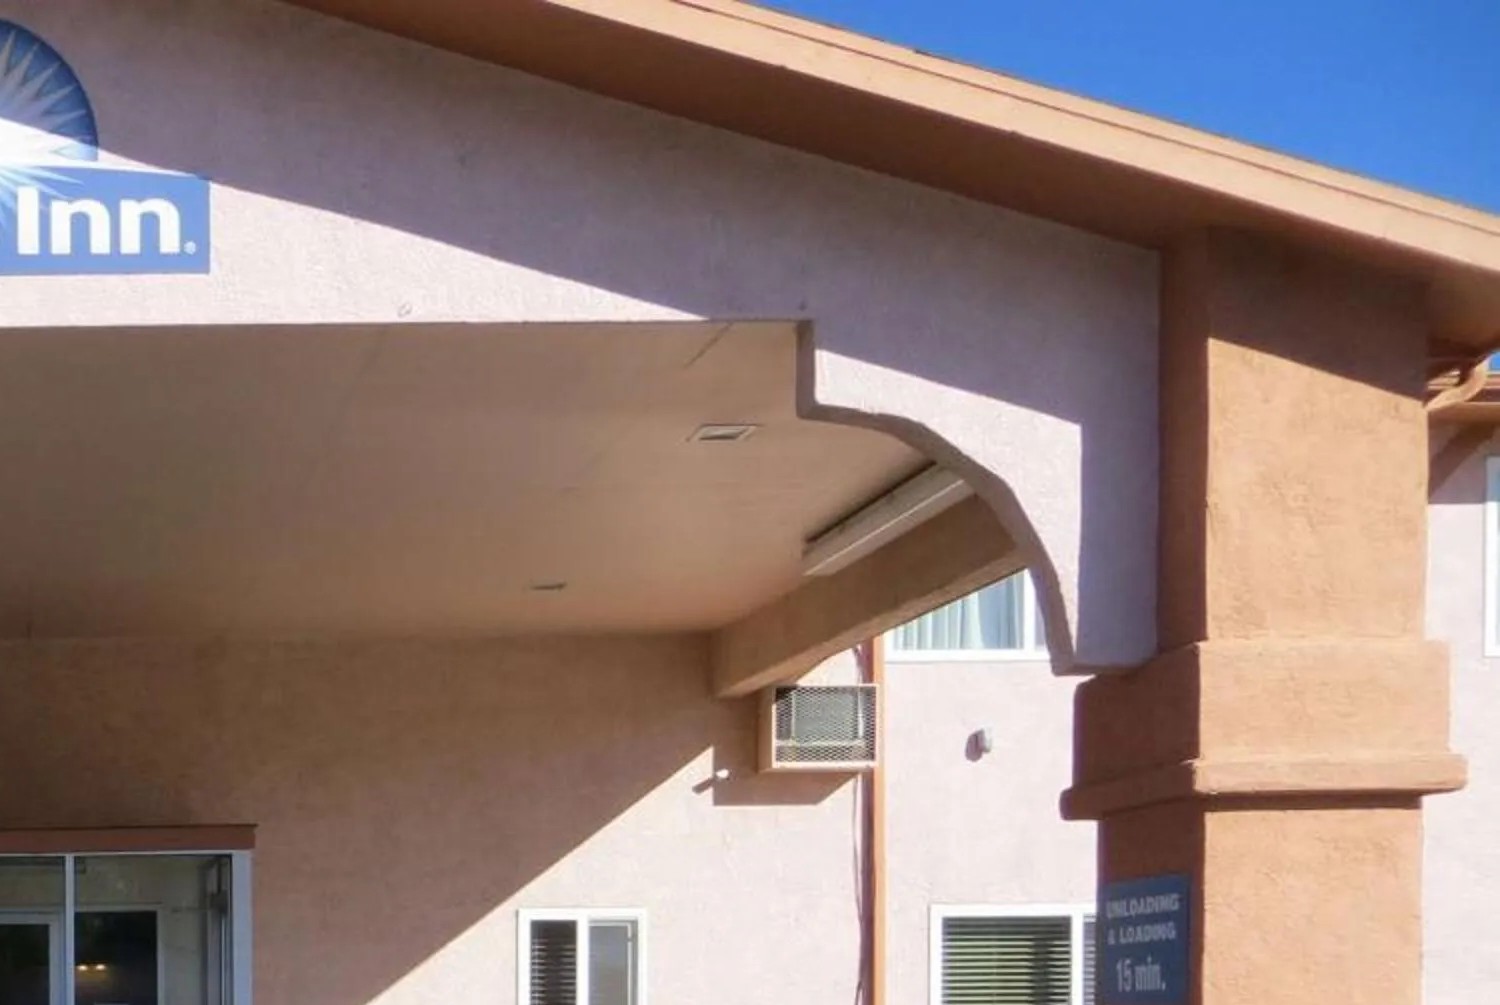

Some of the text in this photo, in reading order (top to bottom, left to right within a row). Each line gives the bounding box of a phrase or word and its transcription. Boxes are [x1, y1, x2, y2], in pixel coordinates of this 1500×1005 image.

[1105, 892, 1181, 919] UNLOADING
[1119, 921, 1177, 944] LOADING
[1116, 956, 1167, 992] 15 min.
